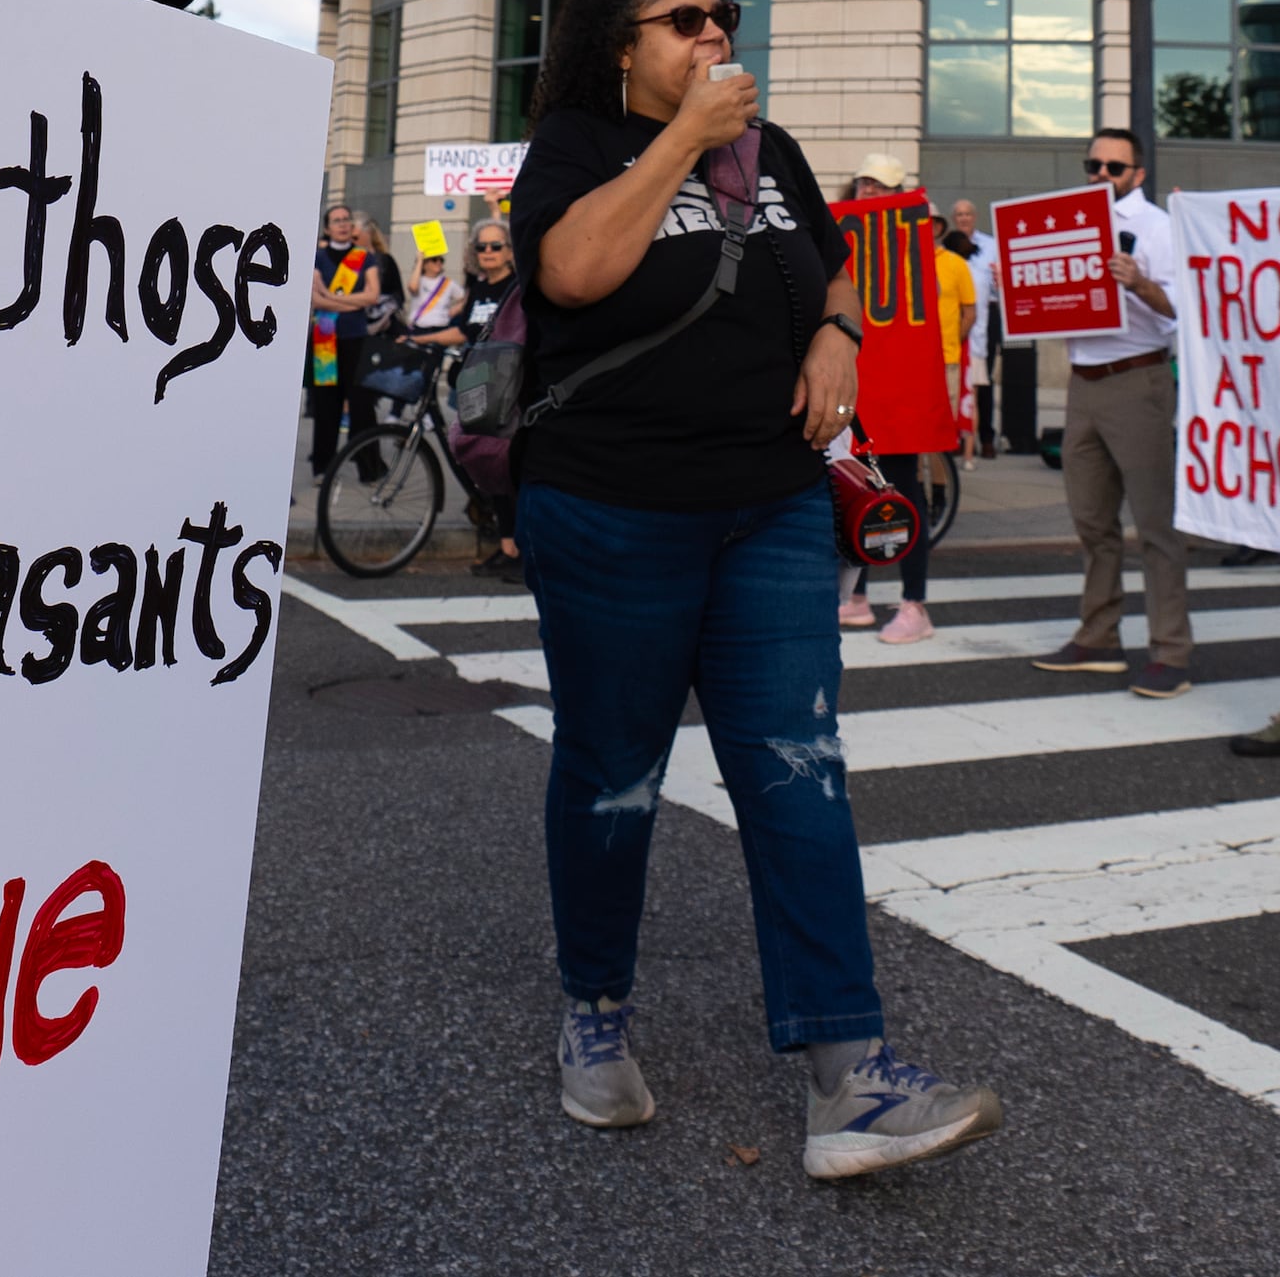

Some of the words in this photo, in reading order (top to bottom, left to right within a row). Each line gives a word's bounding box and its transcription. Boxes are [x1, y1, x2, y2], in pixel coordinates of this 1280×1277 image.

[428, 148, 490, 169] HANDS
[443, 172, 468, 193] DC
[1010, 258, 1067, 289] FREE
[1068, 254, 1105, 282] DC
[1214, 355, 1264, 410] AT
